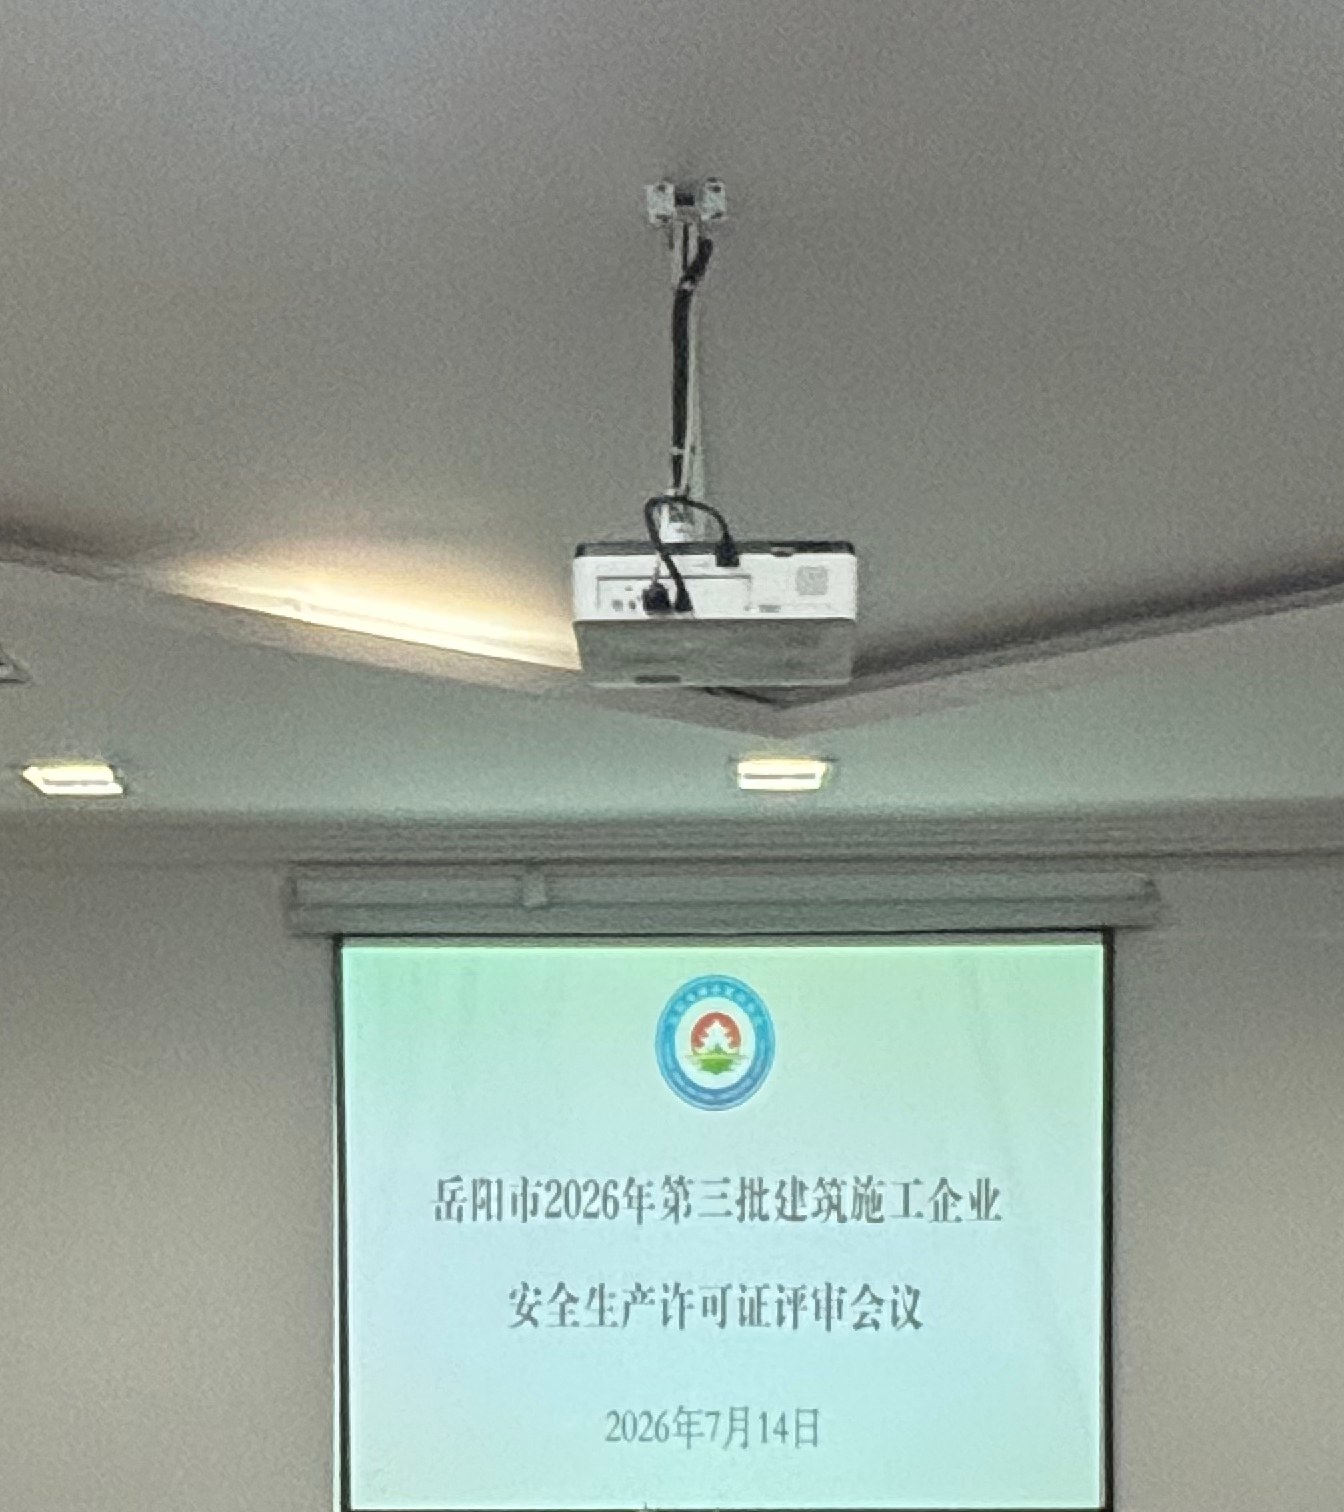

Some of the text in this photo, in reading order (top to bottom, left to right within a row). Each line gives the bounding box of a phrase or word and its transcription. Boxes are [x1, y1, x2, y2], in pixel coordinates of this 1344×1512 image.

[432, 1174, 1004, 1226] 岳阳市2026年第三批建筑施工企业
[507, 1280, 925, 1333] 安全生产许可证评审会议
[604, 1405, 822, 1452] 2026年7月14日
